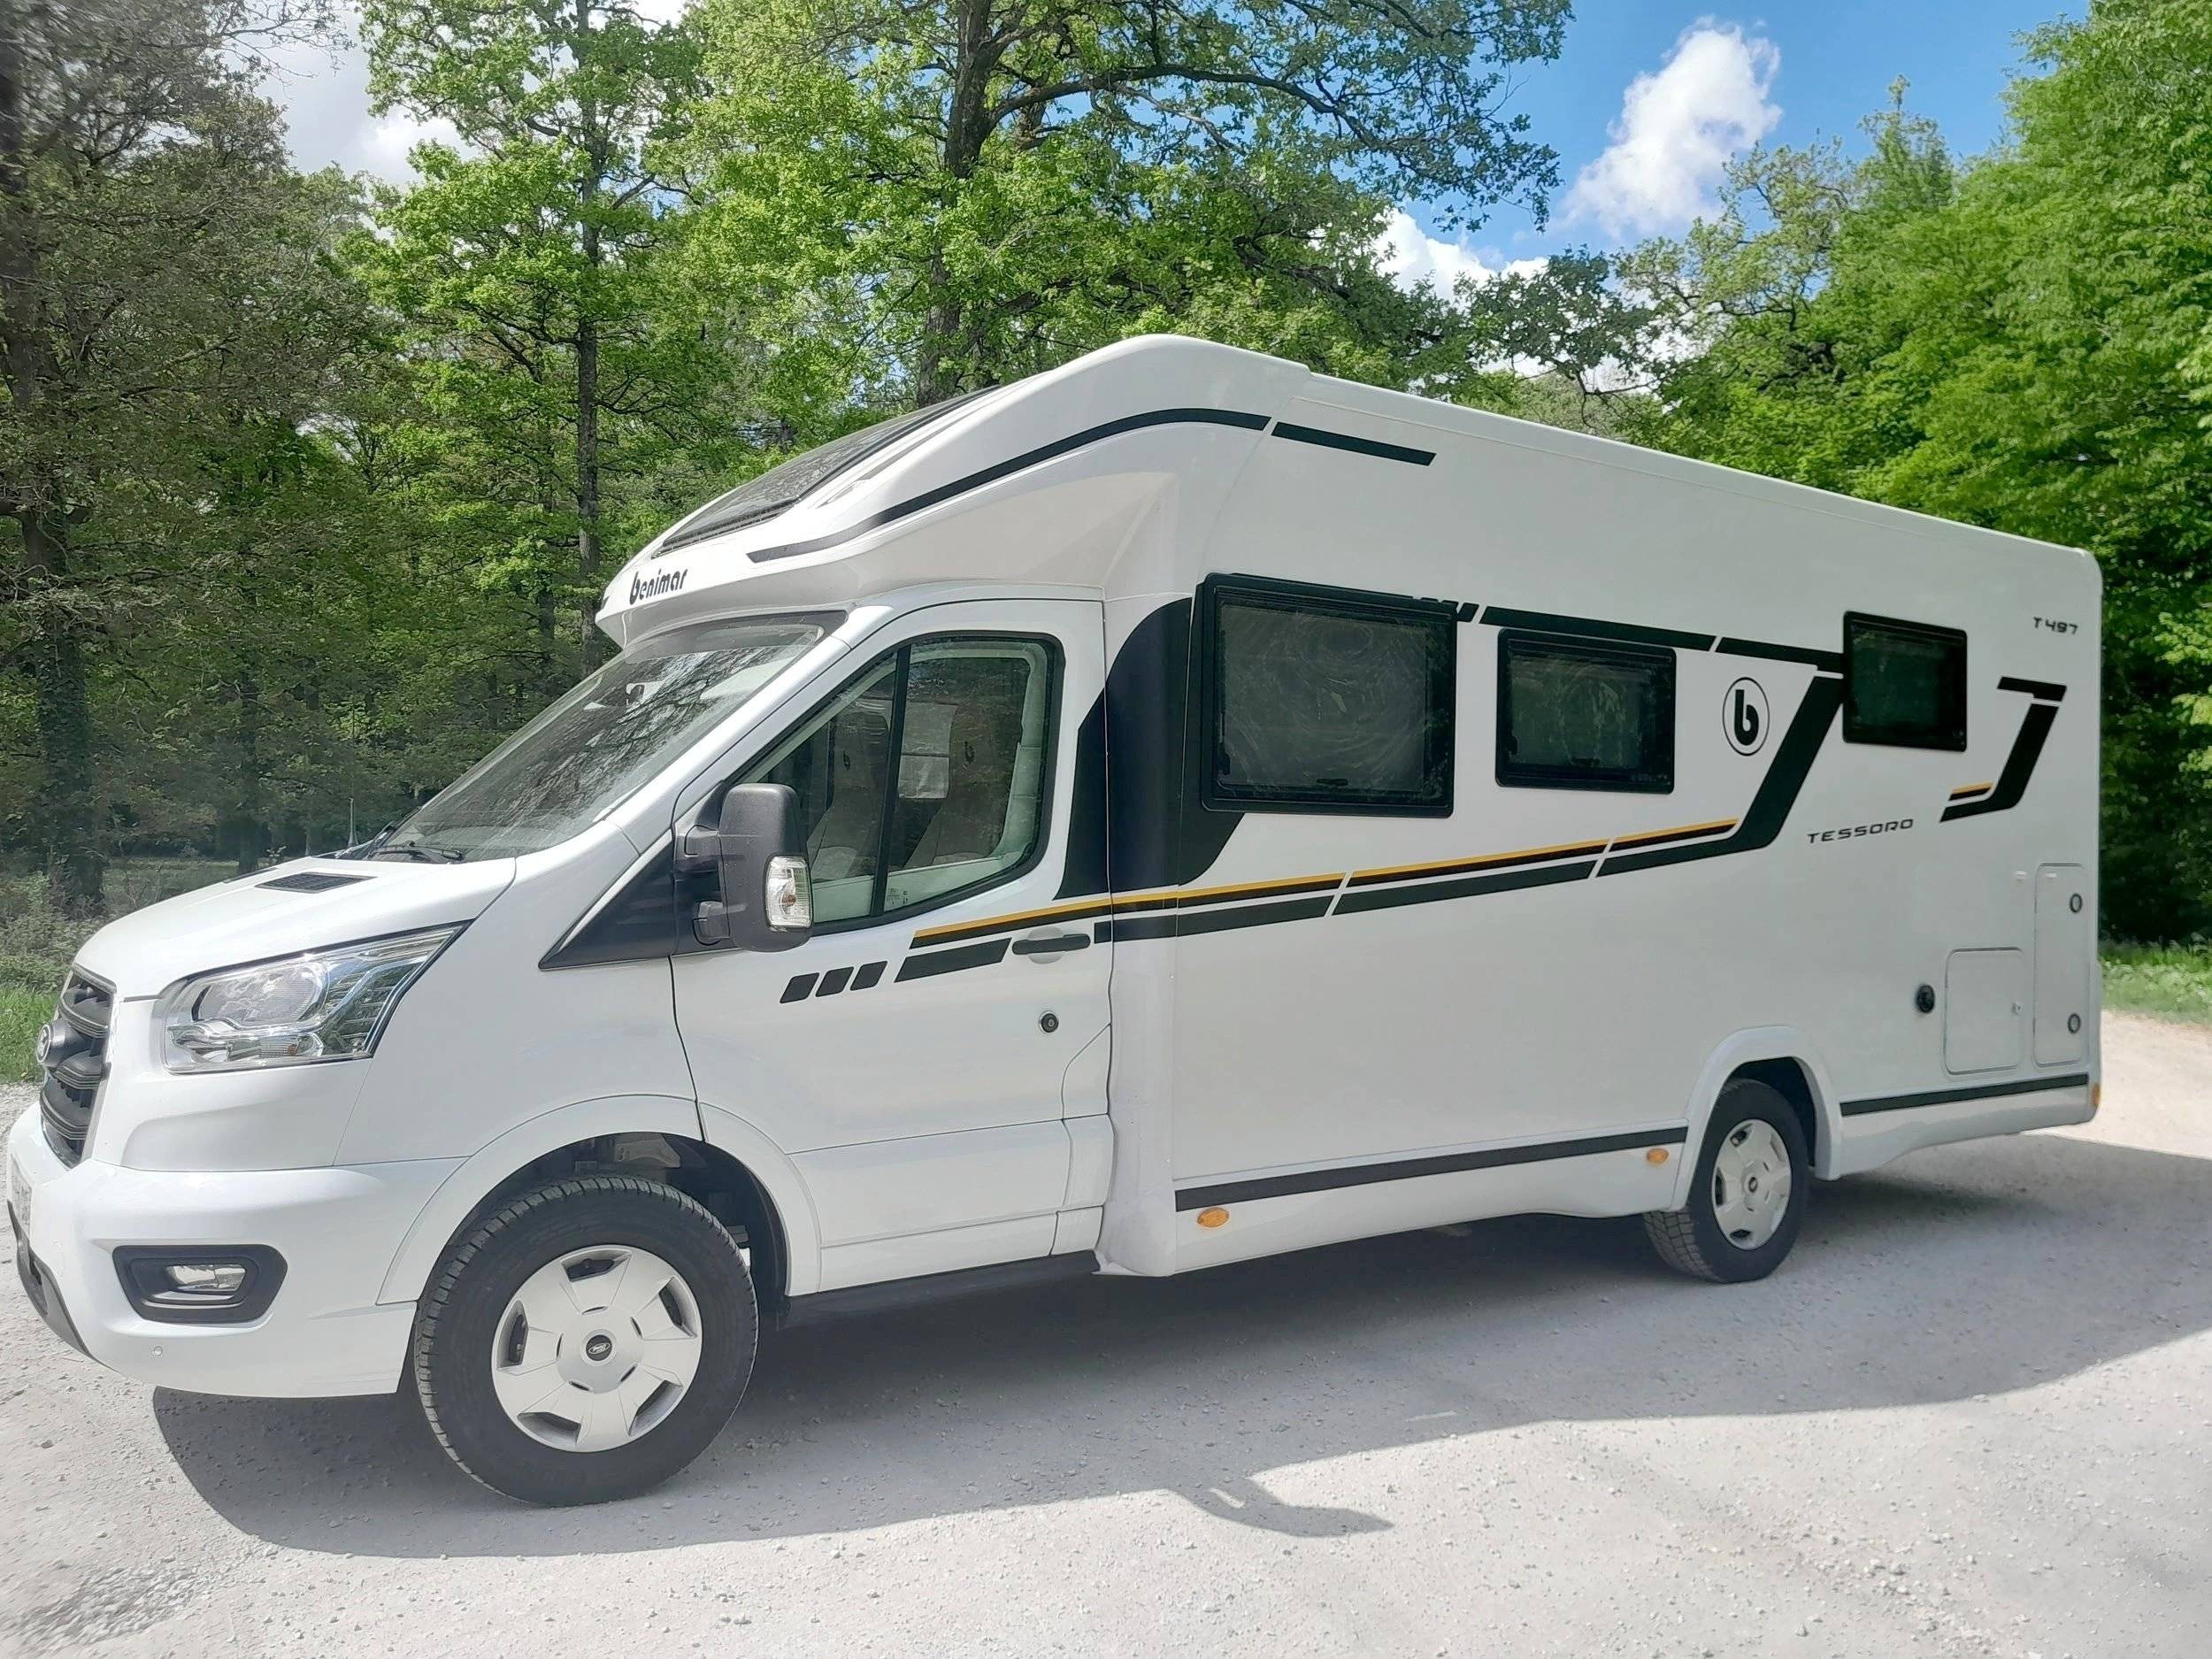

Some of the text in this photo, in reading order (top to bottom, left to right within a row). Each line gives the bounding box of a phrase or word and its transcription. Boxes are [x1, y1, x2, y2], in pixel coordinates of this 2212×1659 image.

[629, 568, 688, 605] benimar
[2032, 616, 2078, 635] T 497
[1733, 688, 1760, 747] b
[1807, 818, 1914, 844] TESSORO
